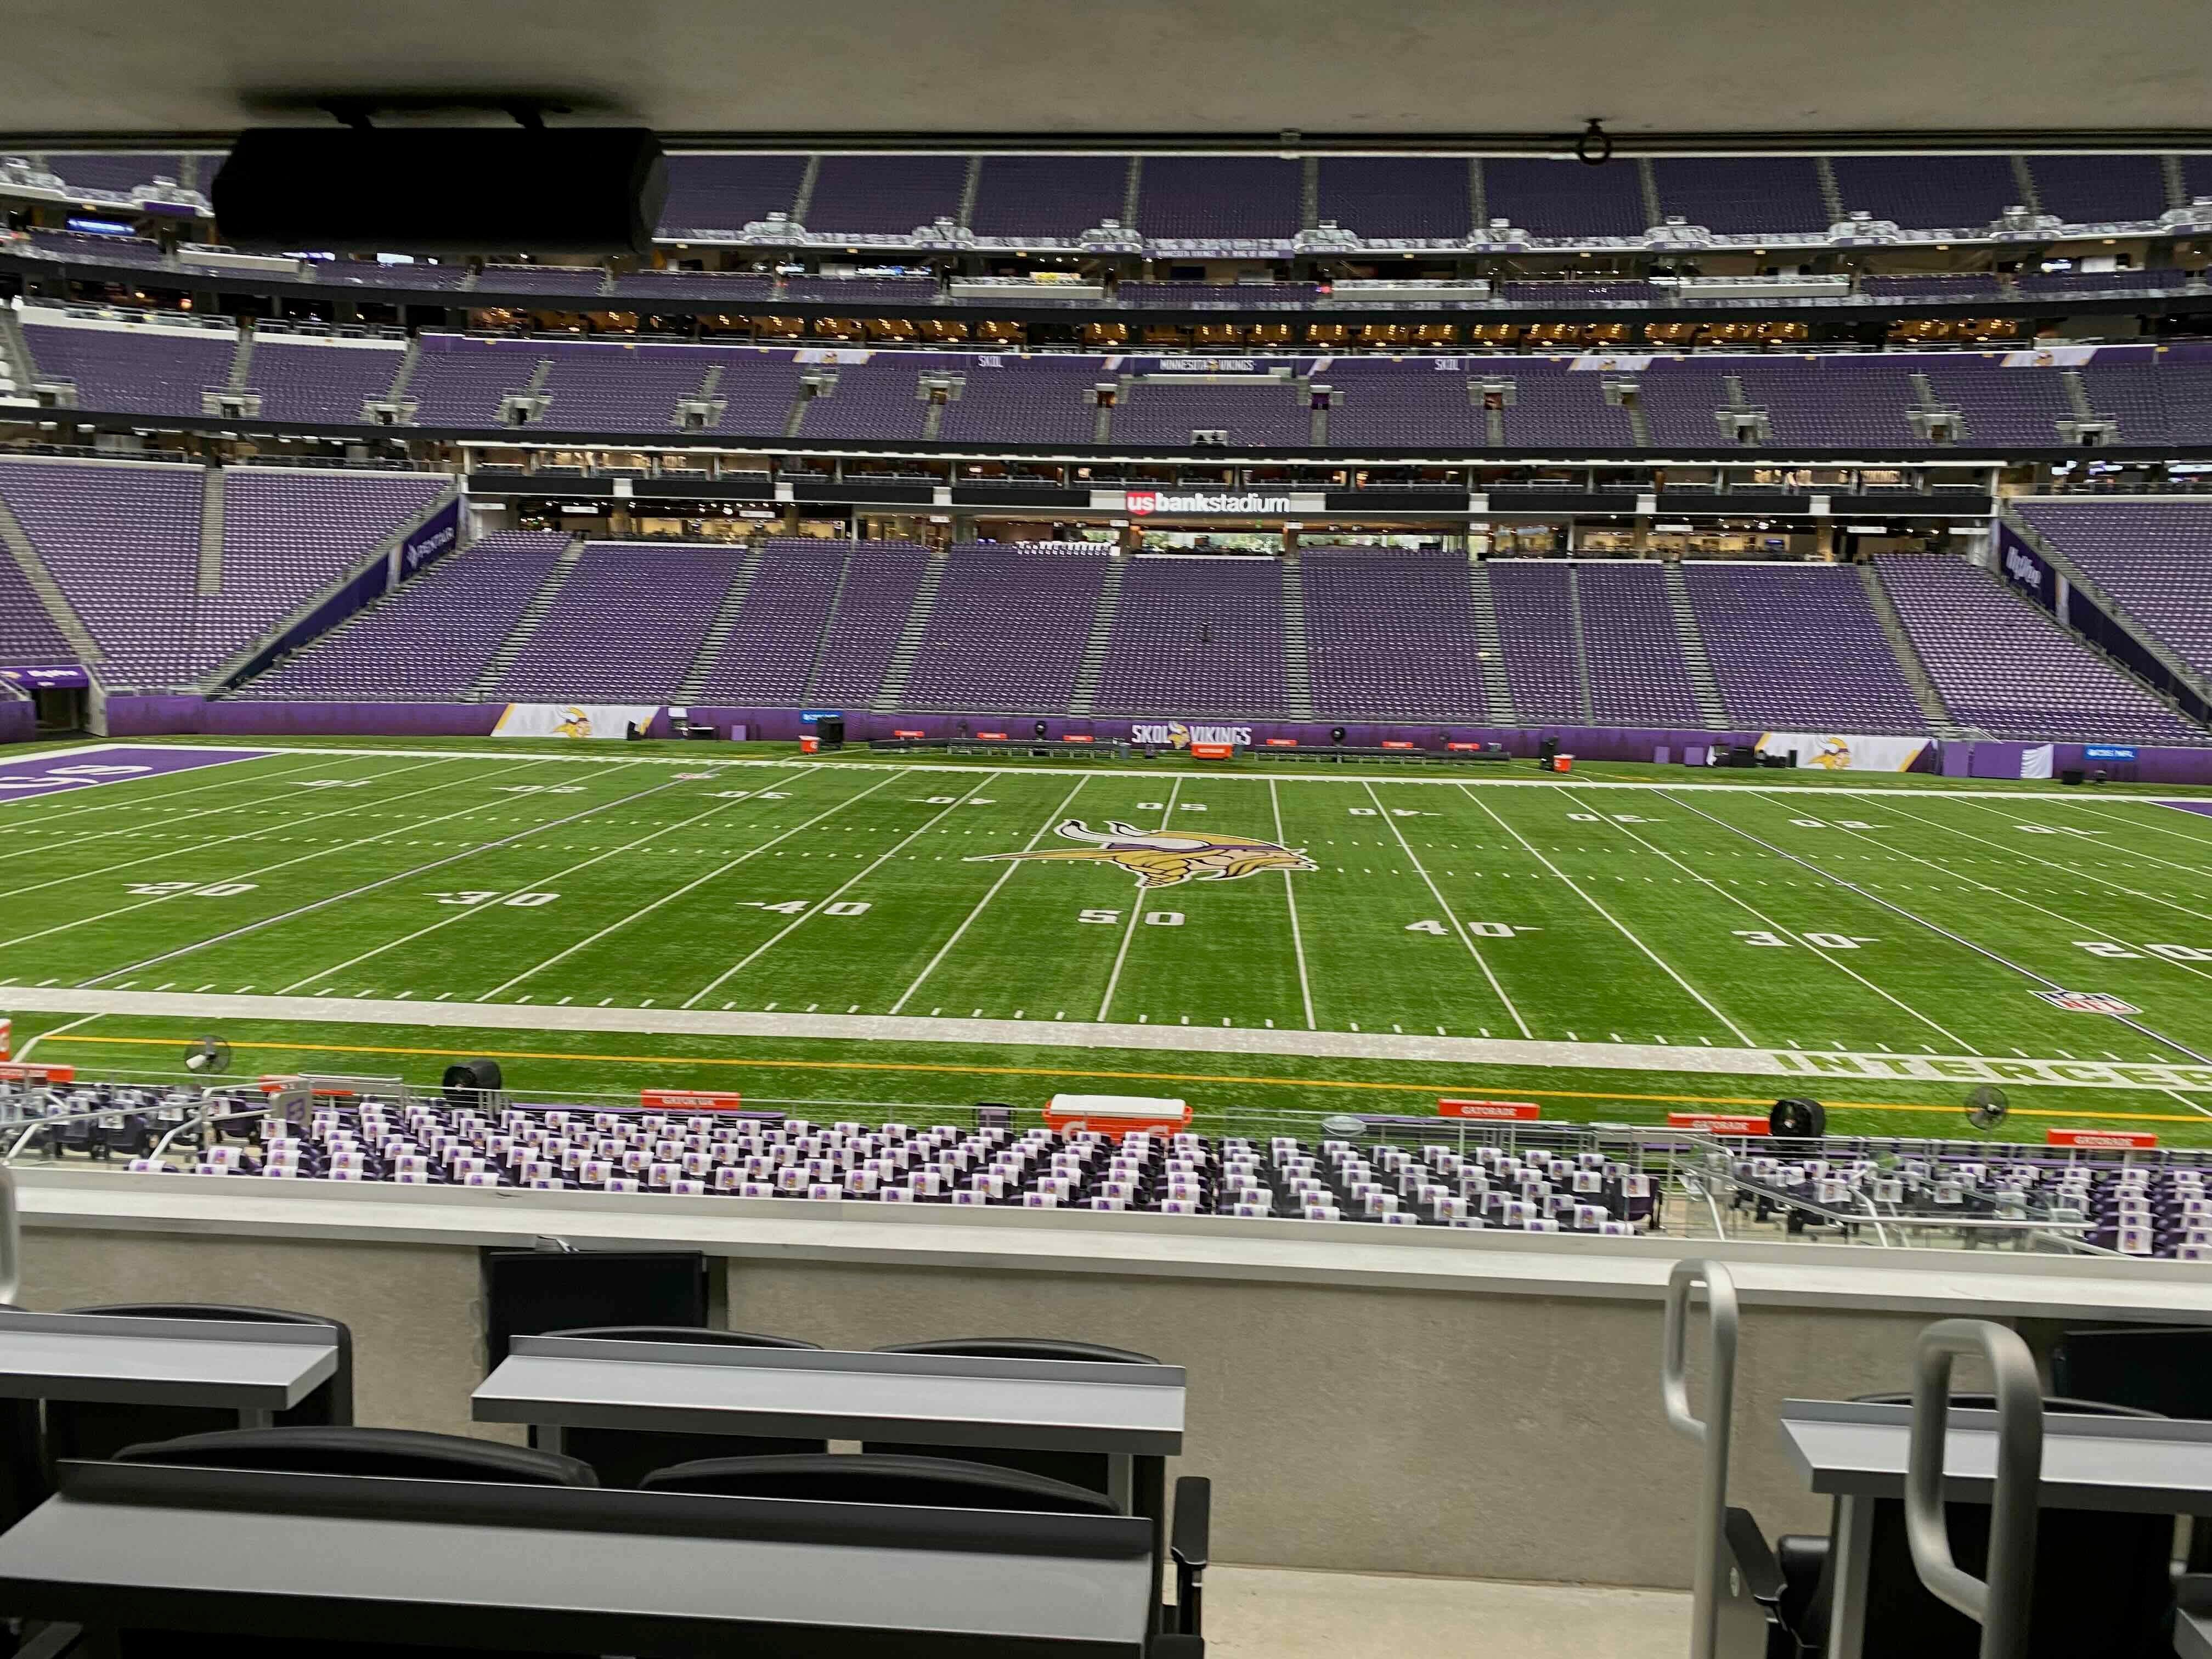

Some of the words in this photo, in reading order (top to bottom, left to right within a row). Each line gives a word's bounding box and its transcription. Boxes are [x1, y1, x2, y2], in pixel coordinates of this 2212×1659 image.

[1132, 725, 1172, 743] SKOL
[1189, 726, 1252, 745] VIKINGS
[2058, 1001, 2129, 1011] NFL
[1461, 1105, 1517, 1116] GATORADE
